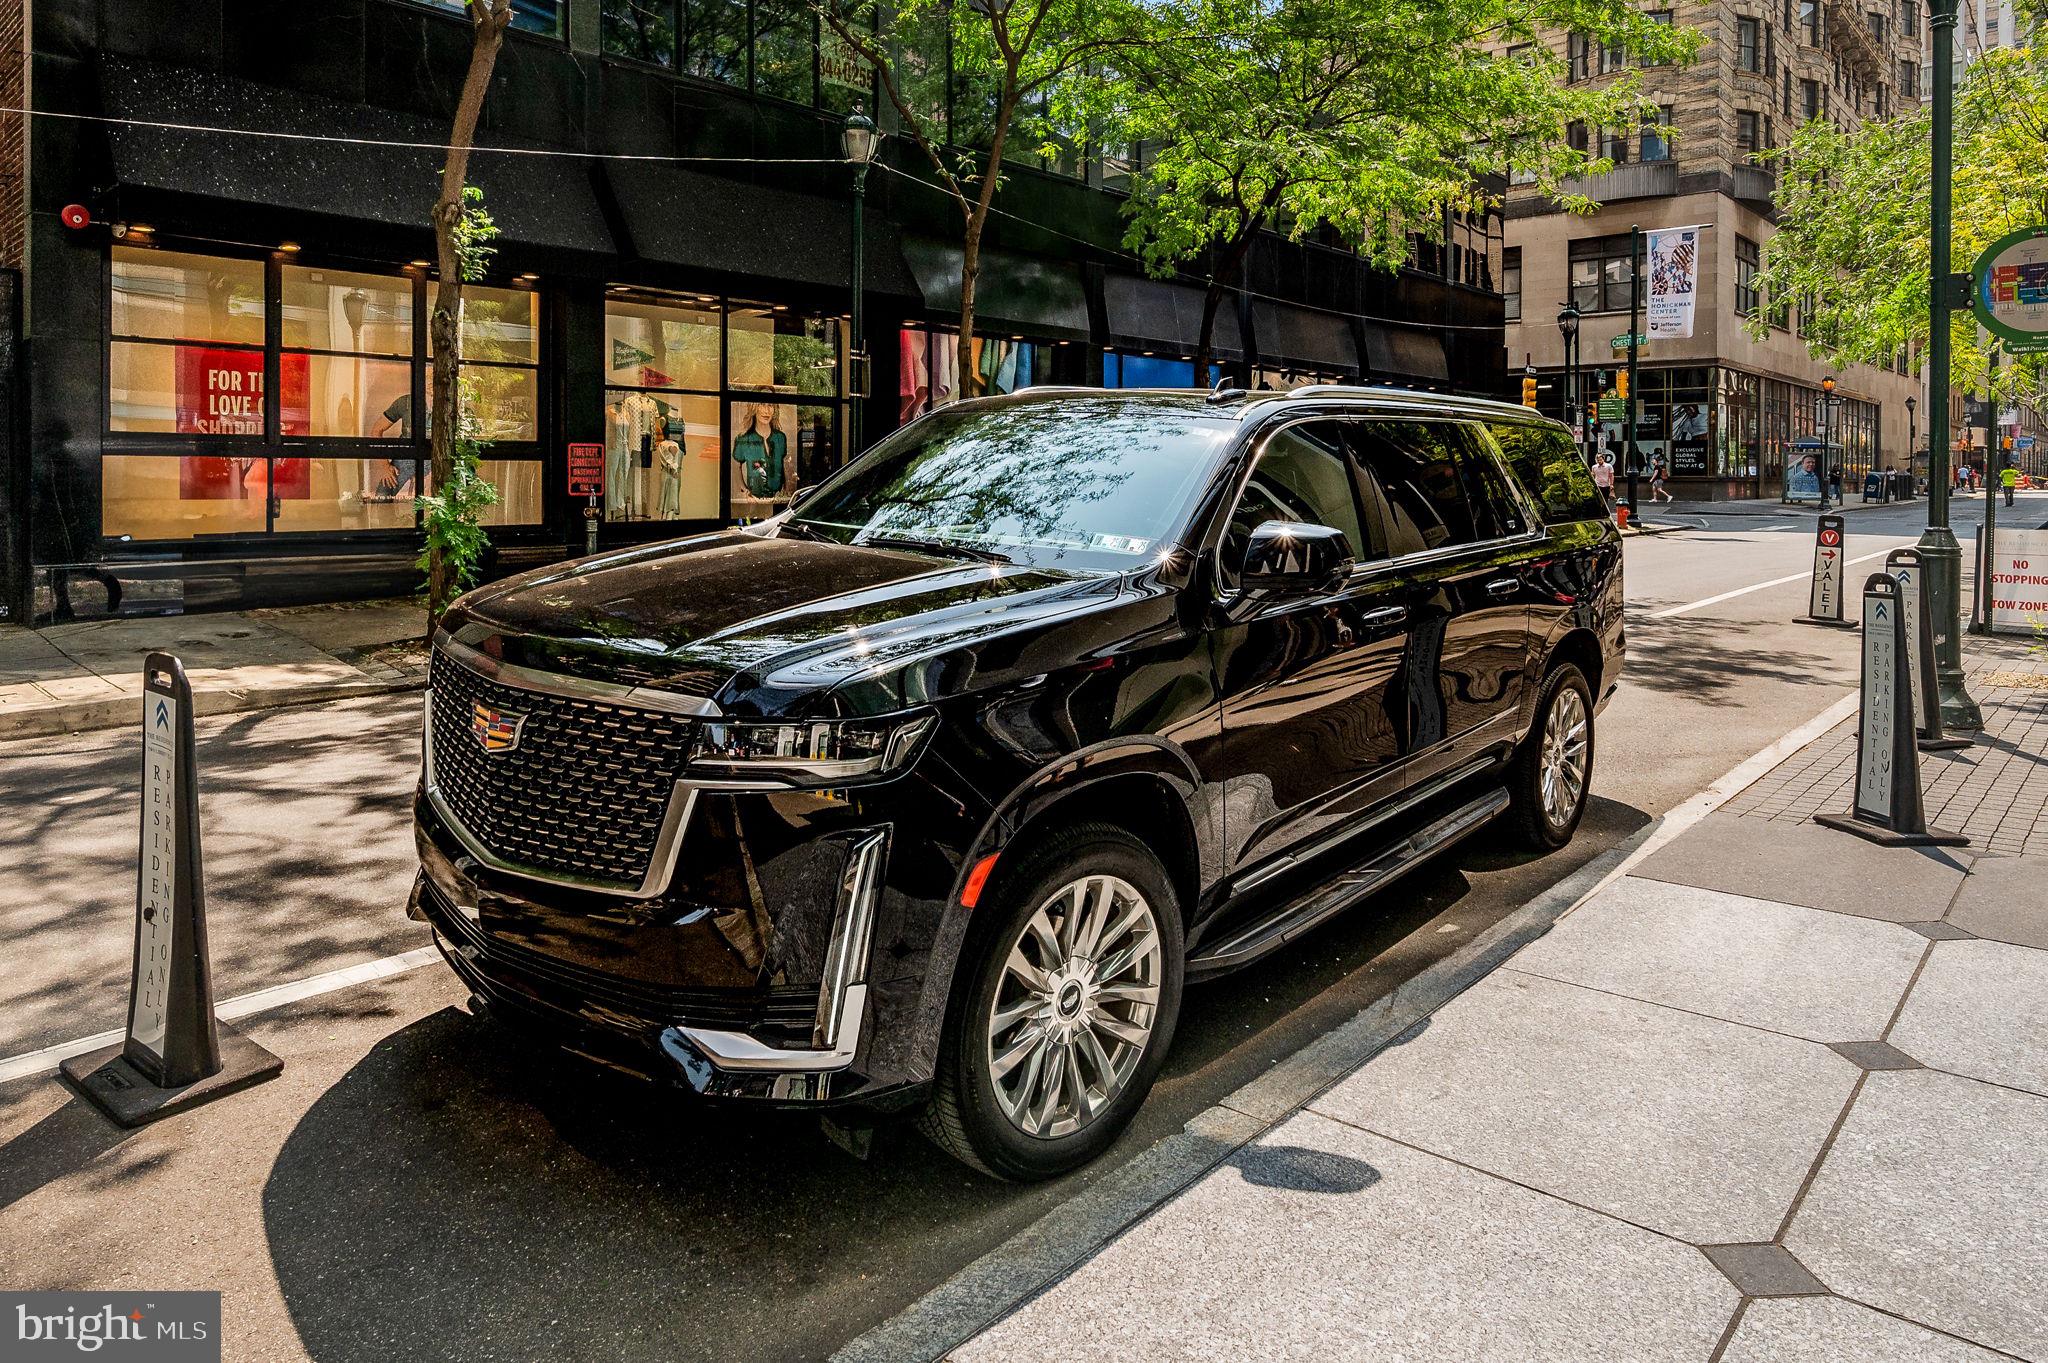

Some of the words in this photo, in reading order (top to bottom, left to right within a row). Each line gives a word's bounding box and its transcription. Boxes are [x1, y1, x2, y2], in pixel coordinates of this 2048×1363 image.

[1612, 338, 1642, 347] CHESTT
[208, 369, 242, 392] FOR
[209, 394, 252, 416] LOVE
[1825, 533, 1835, 543] V
[1821, 560, 1833, 613] VALET
[1991, 574, 2048, 585] STOPPING
[2012, 560, 2029, 569] NO
[1991, 600, 2016, 609] TOW
[2018, 601, 2048, 611] ZONE
[1905, 601, 1915, 671] PARKING
[1882, 643, 1890, 737] PARKING
[1910, 680, 1918, 719] ONY
[1868, 642, 1880, 790] RESIDENTIAL
[1879, 750, 1888, 802] ONLY
[162, 769, 172, 924] PARKING
[145, 764, 161, 1009] RESIDENTIAL
[154, 944, 168, 1030] ONLY
